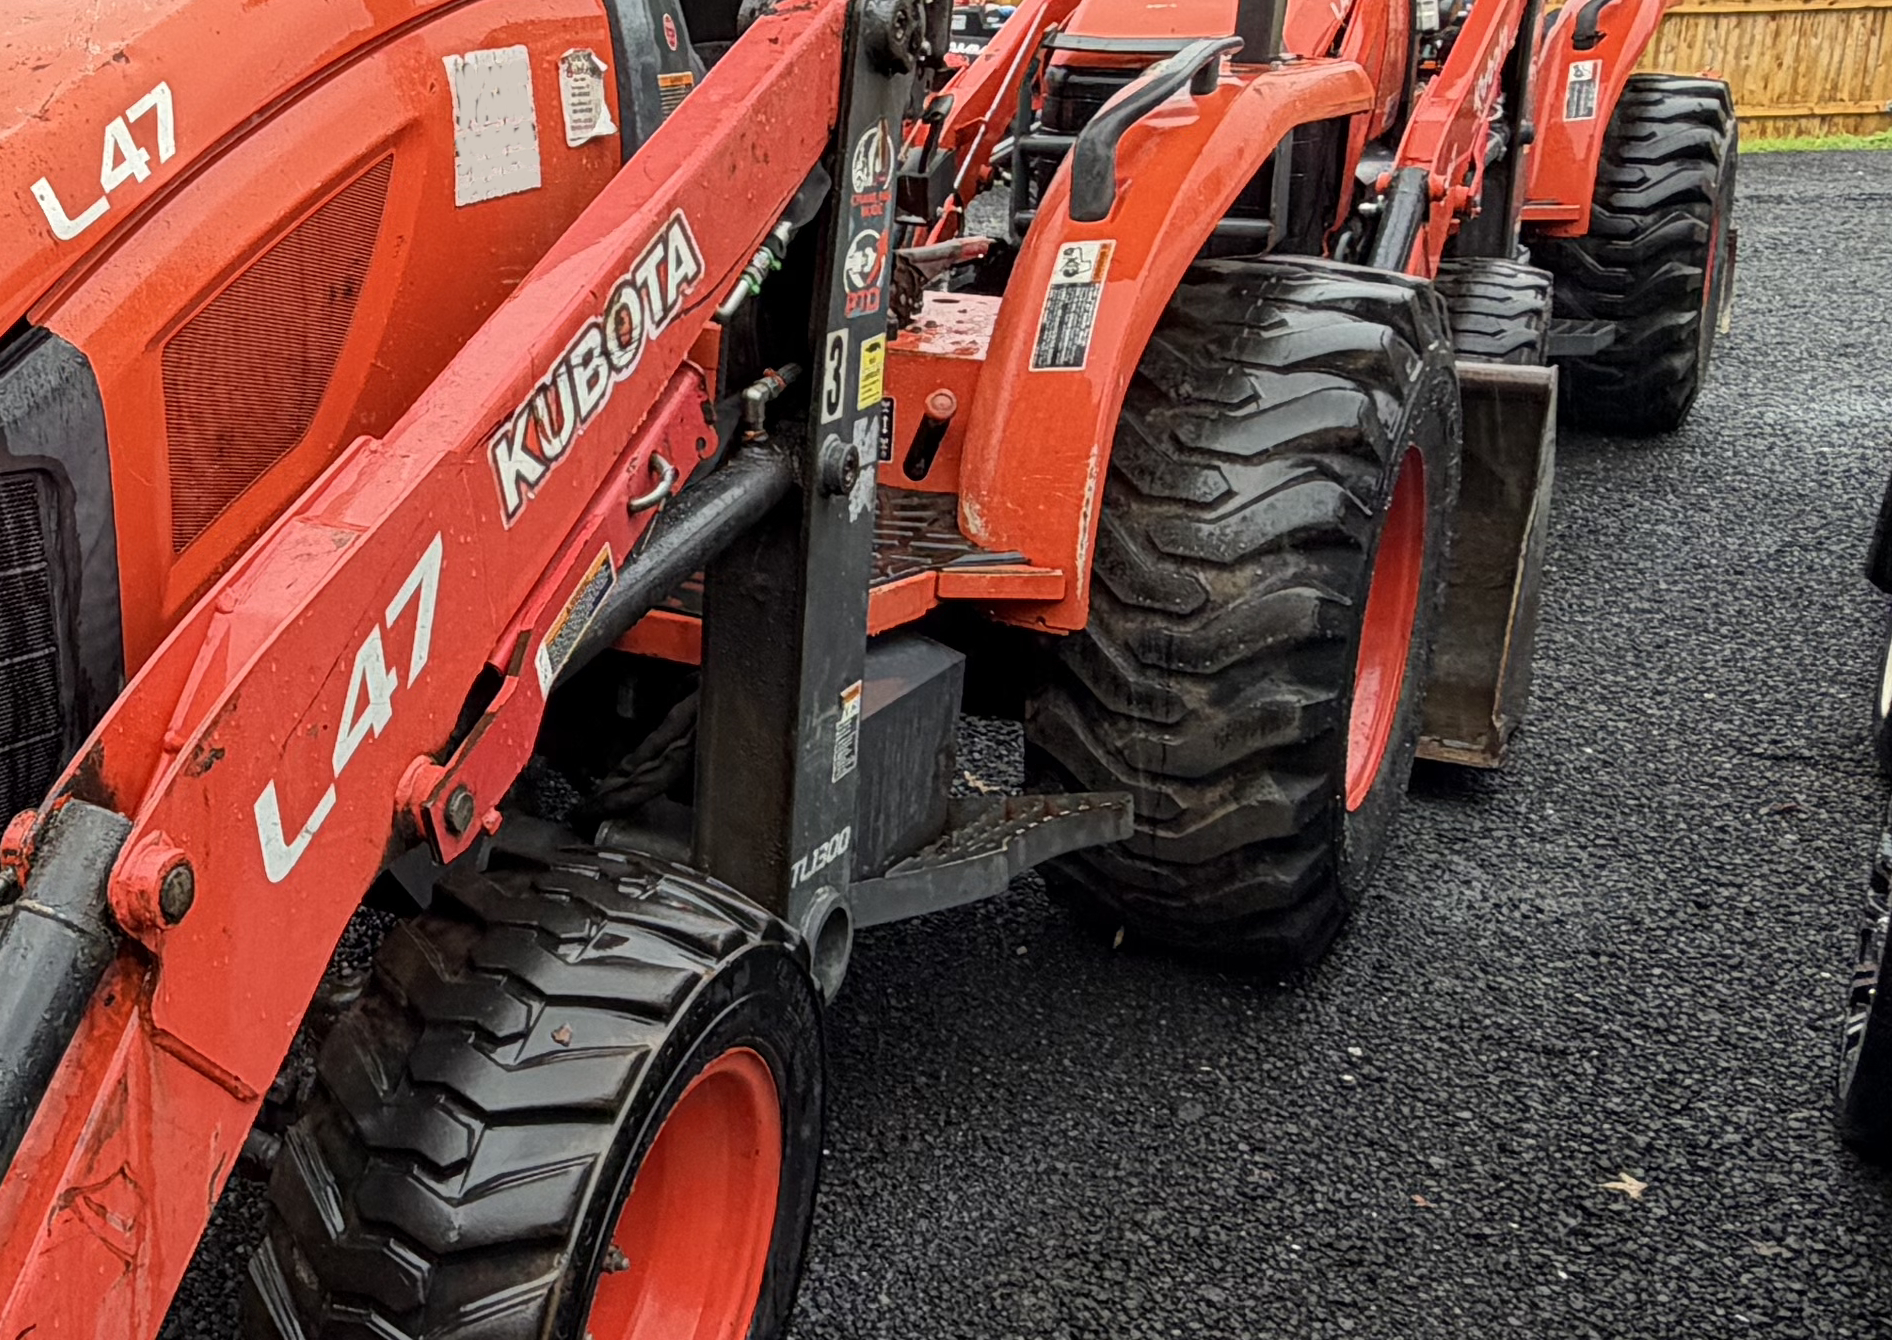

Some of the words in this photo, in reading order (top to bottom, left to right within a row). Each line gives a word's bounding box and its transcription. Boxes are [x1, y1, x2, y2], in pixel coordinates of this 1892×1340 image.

[29, 80, 177, 241] L47
[490, 212, 702, 521] KUBOTA
[826, 334, 844, 416] 3
[253, 530, 443, 883] L47
[791, 825, 852, 890] TL1300
